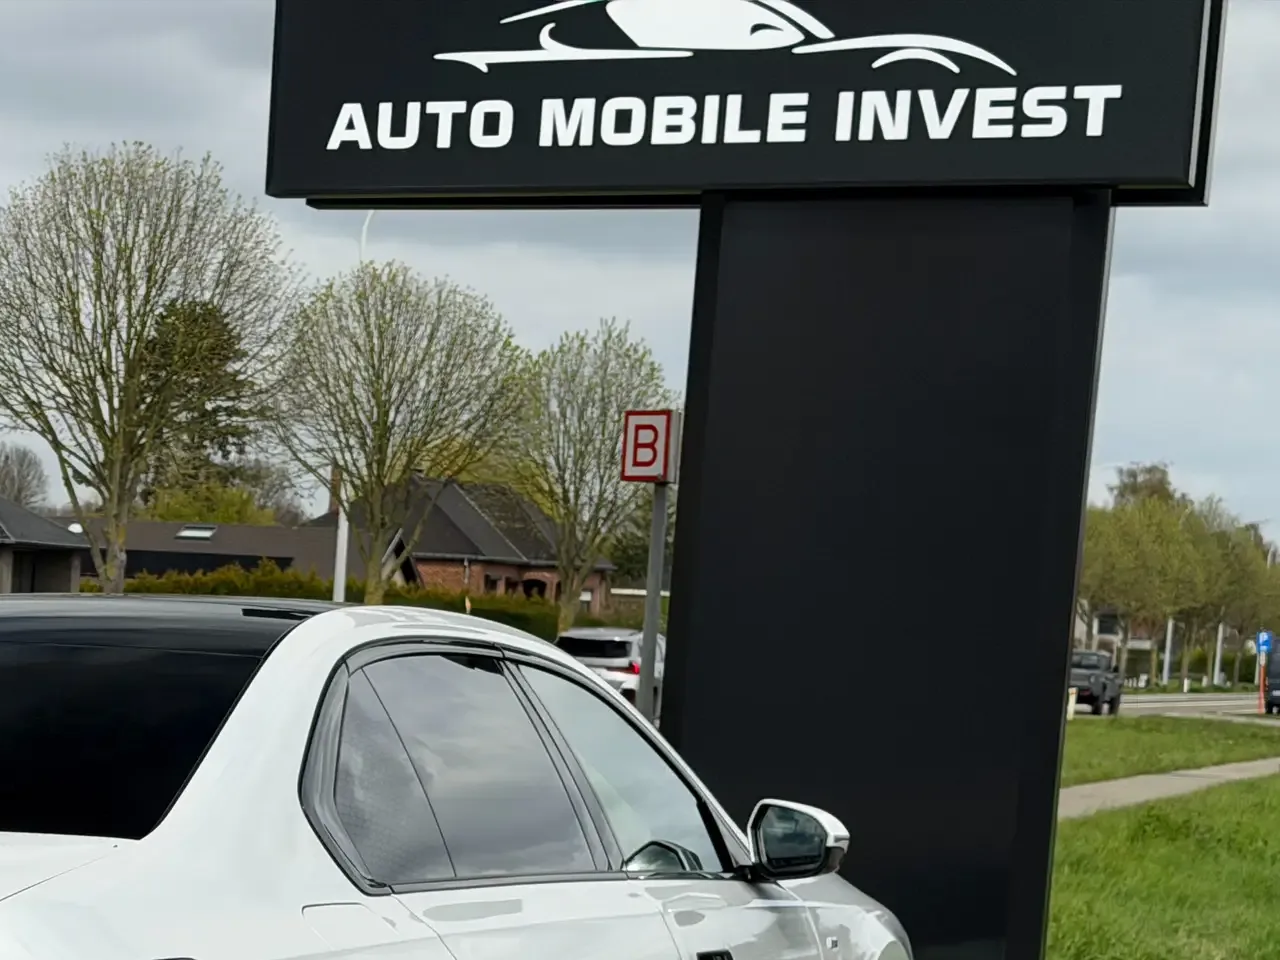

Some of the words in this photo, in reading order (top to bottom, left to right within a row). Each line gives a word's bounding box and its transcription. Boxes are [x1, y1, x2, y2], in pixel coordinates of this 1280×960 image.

[326, 99, 514, 150] AUTO
[538, 92, 810, 147] MOBILE
[835, 85, 1122, 142] INVEST
[633, 424, 659, 467] B
